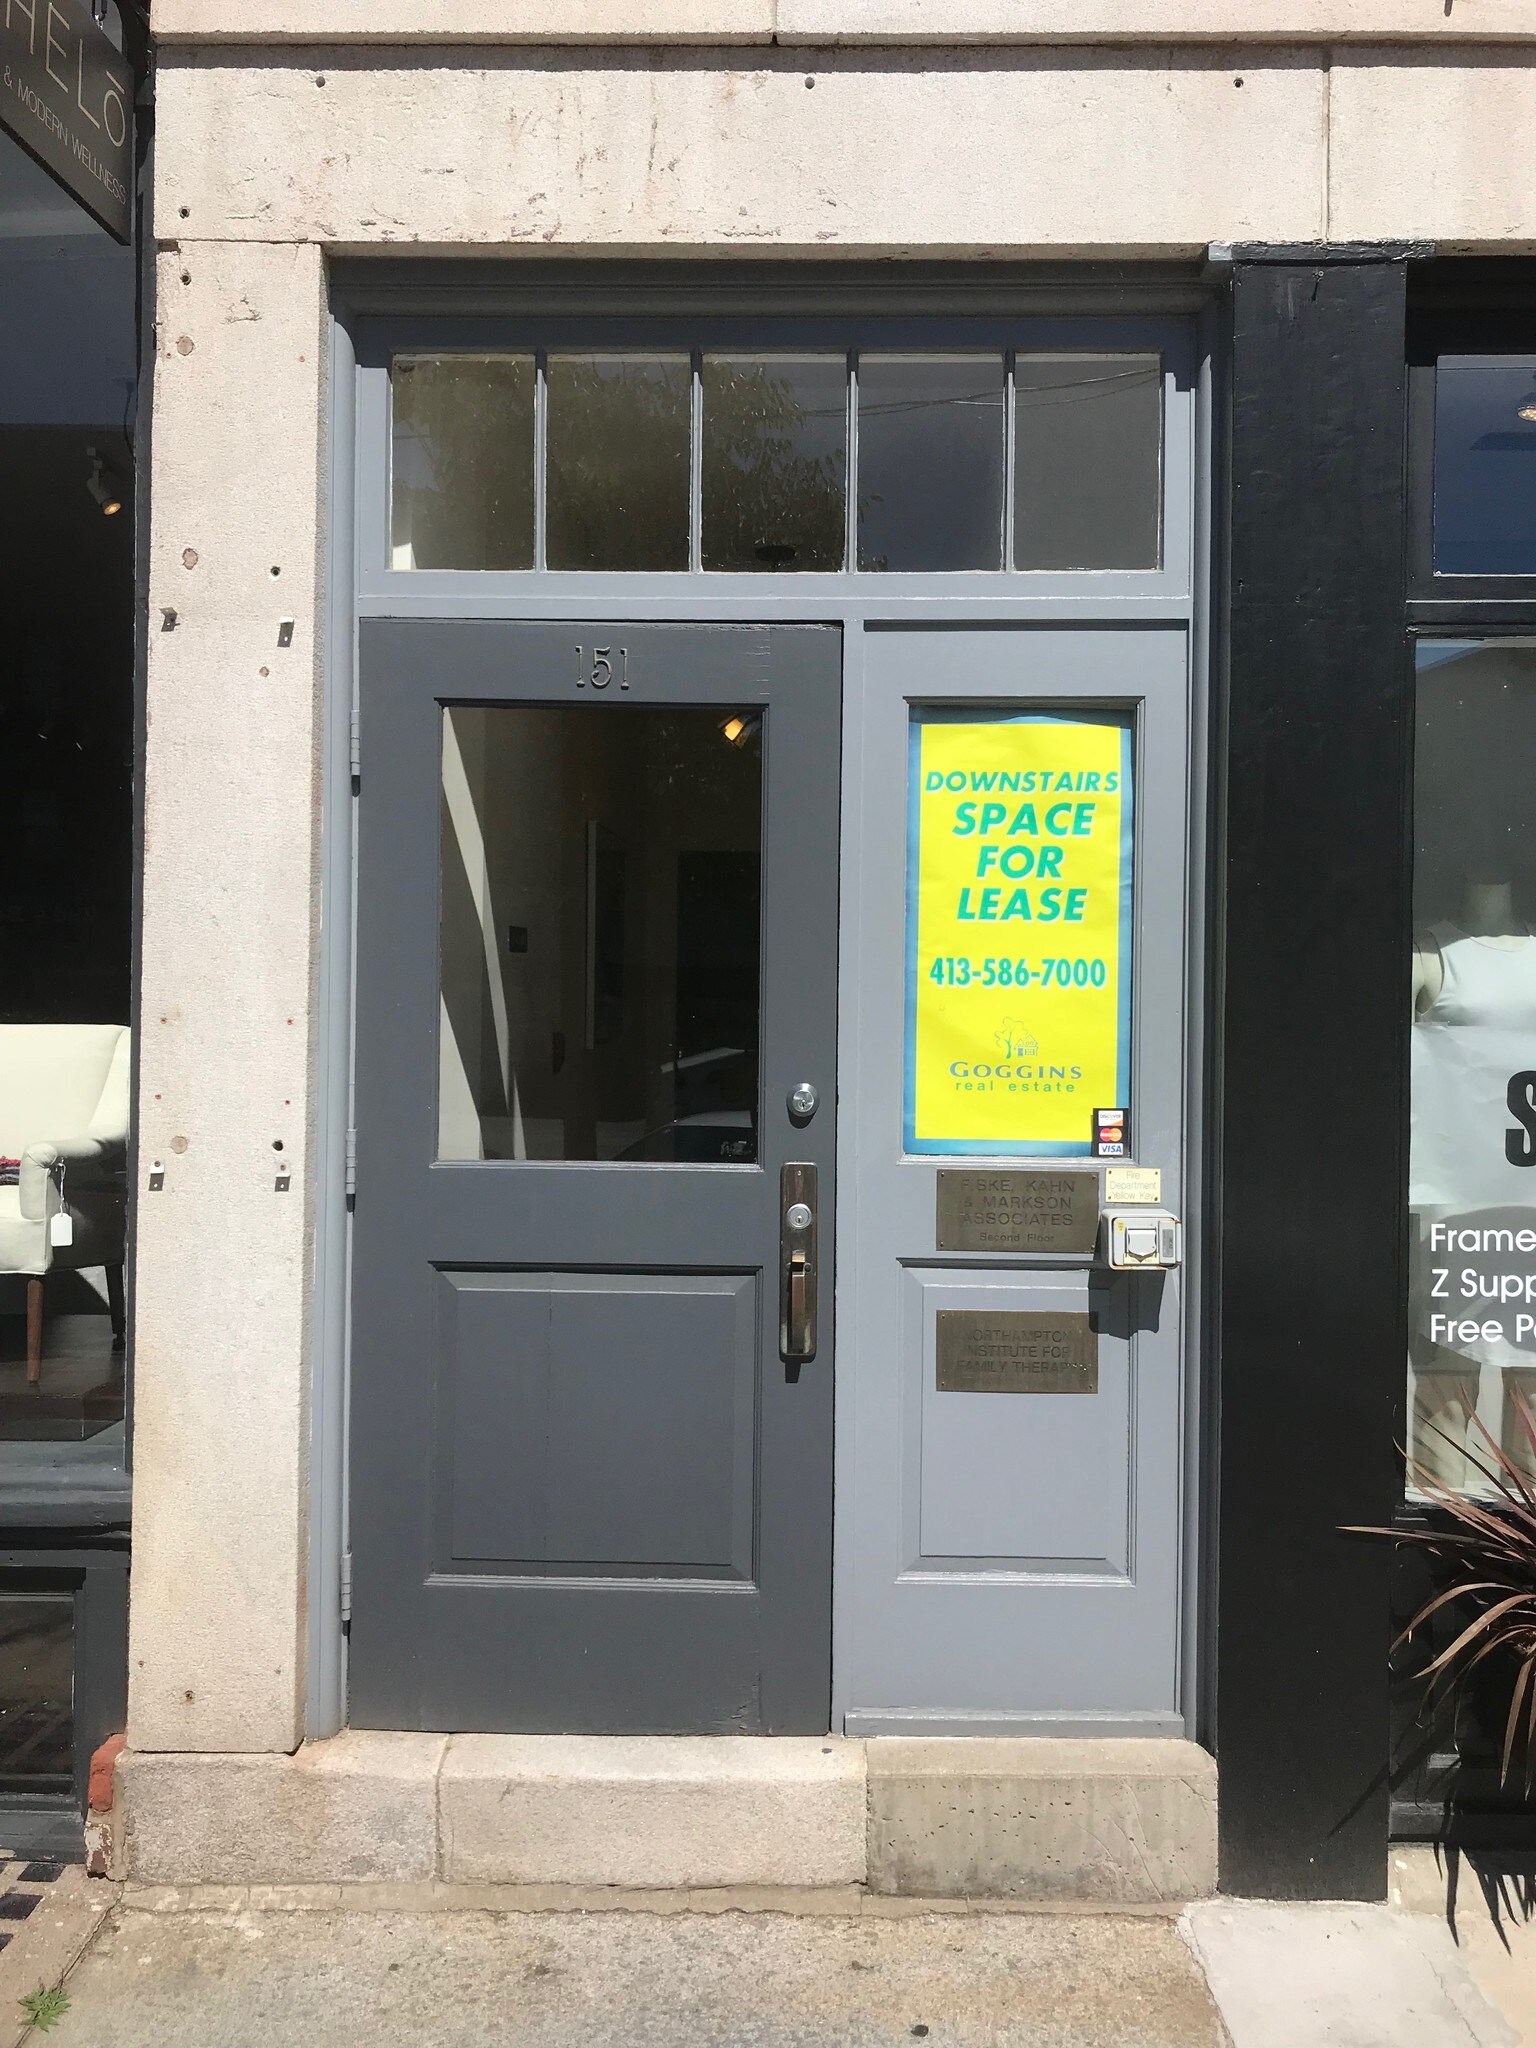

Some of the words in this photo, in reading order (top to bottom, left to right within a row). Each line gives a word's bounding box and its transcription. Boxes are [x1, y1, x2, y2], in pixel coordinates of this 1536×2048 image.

[3, 65, 13, 90] &
[17, 78, 68, 146] MODERN
[71, 133, 126, 205] WELLNESS
[575, 645, 630, 689] 151
[925, 770, 1119, 792] DOWNSTAIRS
[952, 802, 1096, 837] SPACE
[976, 844, 1064, 880] FOR
[956, 887, 1088, 922] LEASE
[929, 957, 1107, 988] 413-586-7000
[949, 1061, 1082, 1080] GOGGINS
[955, 1080, 994, 1091] real
[1008, 1081, 1075, 1093] estate
[1101, 1145, 1122, 1153] VISA
[960, 1178, 1014, 1192] FSKE,
[1025, 1179, 1076, 1193] KAHN
[1109, 1180, 1157, 1190] Department
[983, 1195, 1072, 1209] MARKSON
[1112, 1191, 1136, 1200] Yellow
[1139, 1191, 1155, 1201] Key
[961, 1211, 1074, 1226] ASSOCIATES
[979, 1232, 1020, 1242] Second
[1027, 1233, 1055, 1242] Floor
[1430, 1223, 1536, 1252] Frame
[1430, 1268, 1449, 1297] Z
[1430, 1313, 1504, 1343] Free
[1516, 1313, 1536, 1343] P
[965, 1344, 1038, 1358] NSTITUTE
[1011, 1361, 1079, 1374] THERAP
